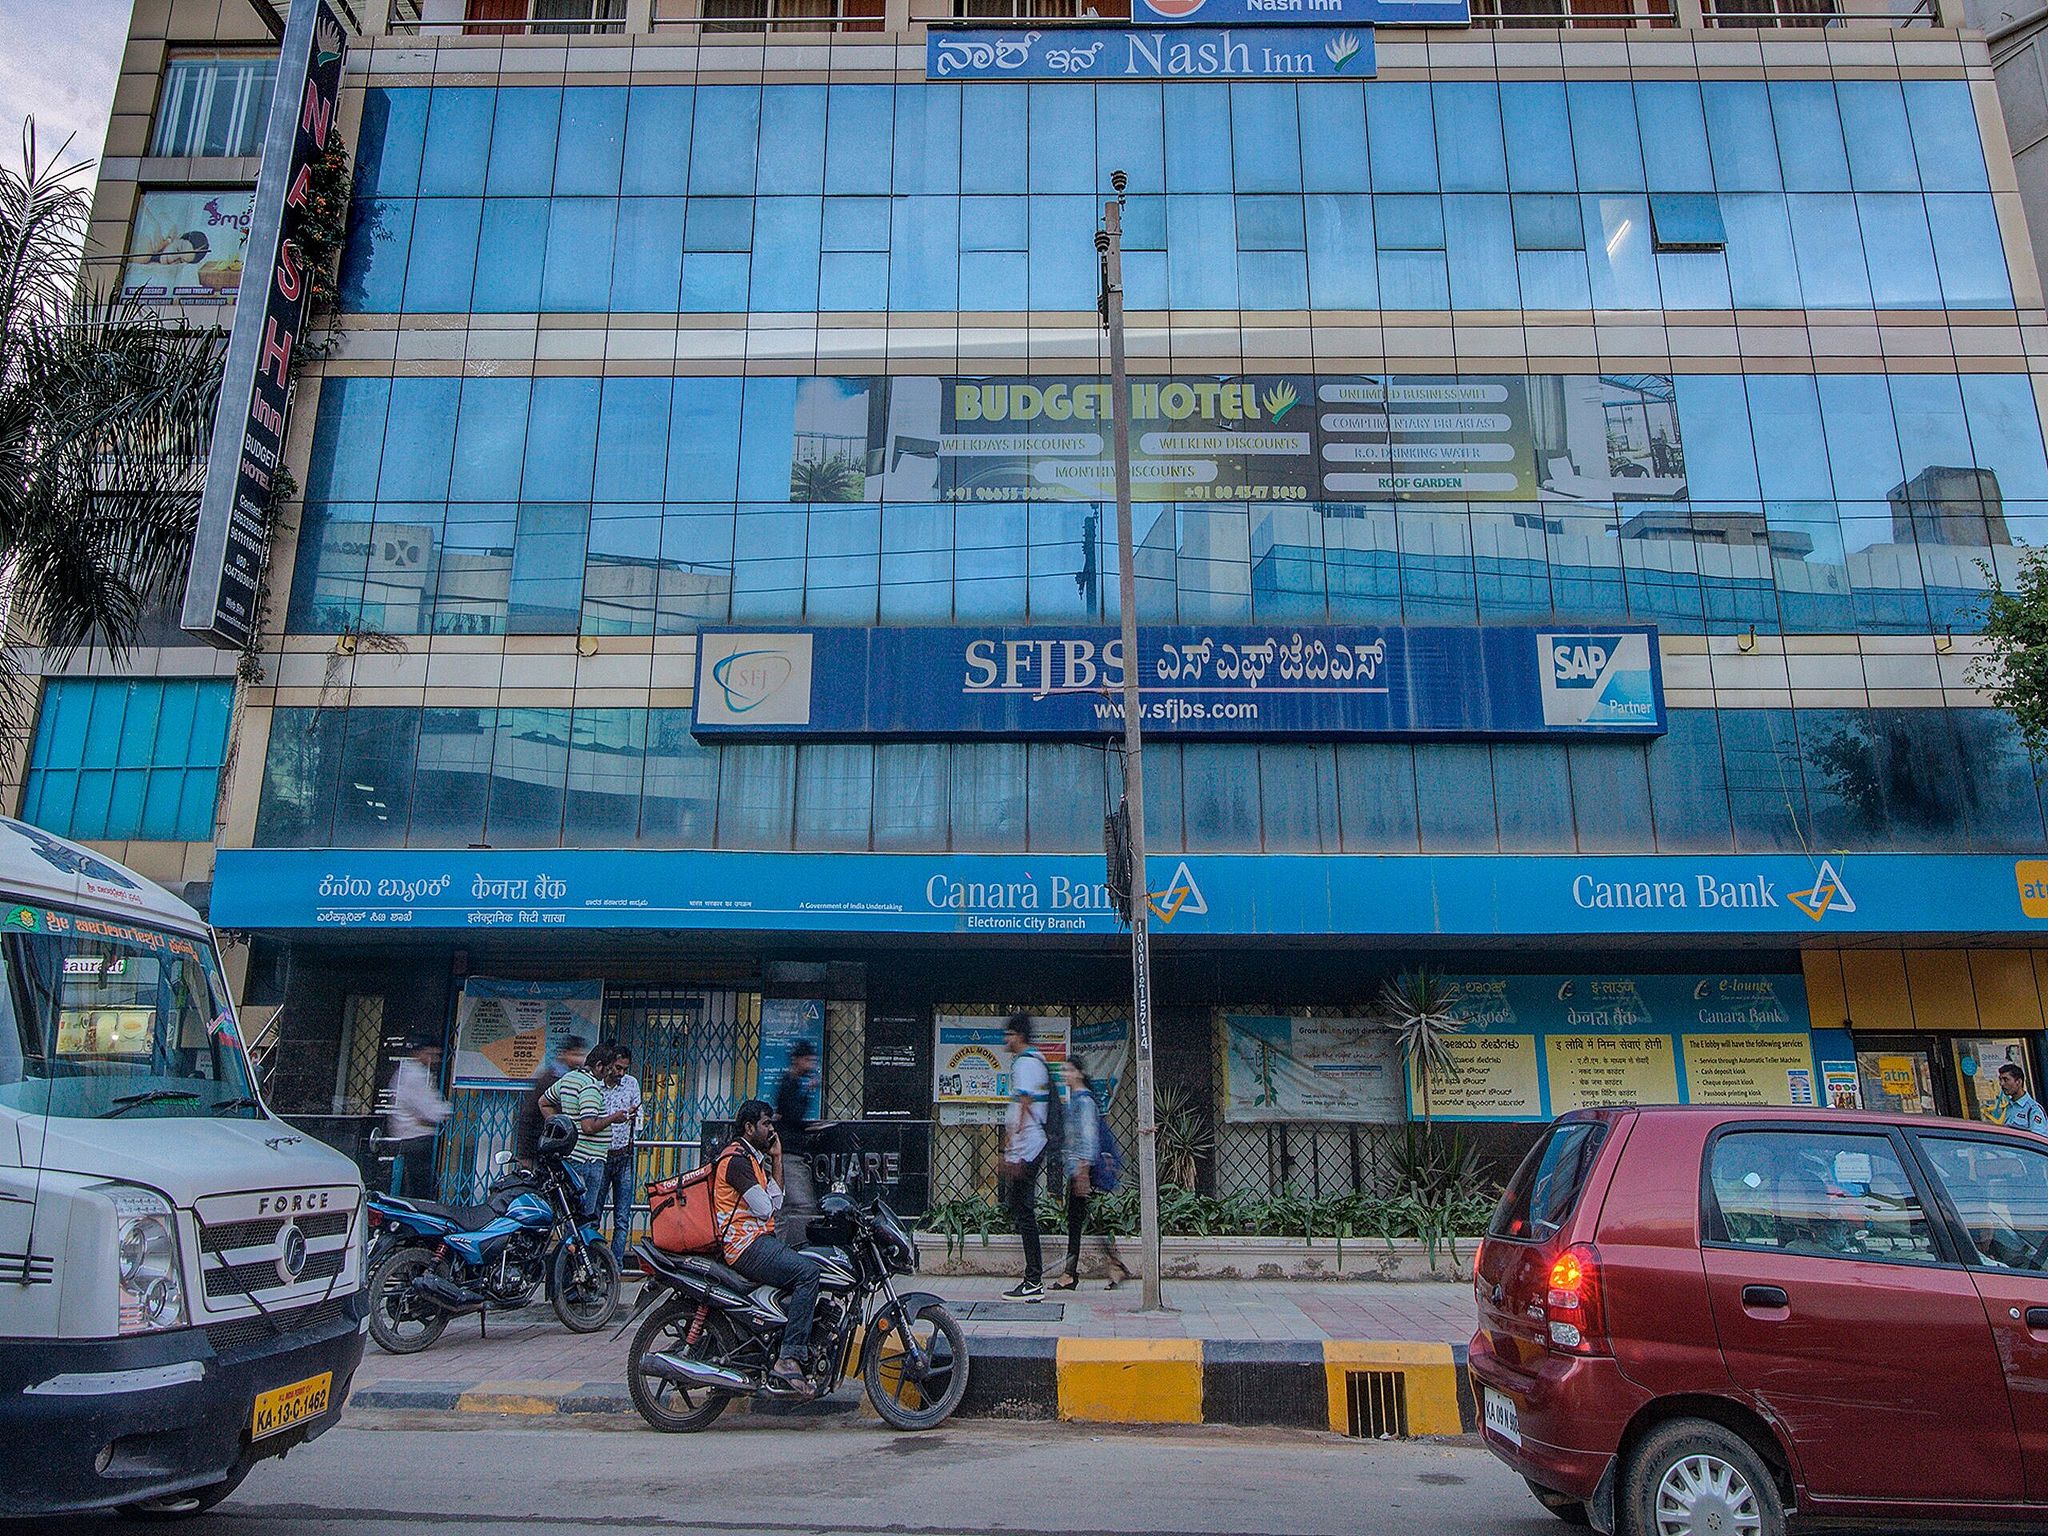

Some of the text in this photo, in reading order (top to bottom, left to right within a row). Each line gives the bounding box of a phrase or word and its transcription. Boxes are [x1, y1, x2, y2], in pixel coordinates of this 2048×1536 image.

[1124, 30, 1316, 75] Nash Inn
[955, 383, 1261, 421] BUDGET HOTEL
[252, 386, 281, 437] Inn
[245, 432, 276, 469] BUDGET
[1013, 437, 1086, 450] DISCOUNTS
[1226, 437, 1298, 449] DISCOUNTS
[241, 458, 271, 491] HOTEL
[1130, 466, 1195, 478] ISCOUNTS
[1378, 477, 1462, 489] ROOF GARDEN
[946, 487, 971, 500] +91
[1185, 486, 1307, 499] +91 80 4347 3030
[964, 639, 1126, 701] SFJBS
[1554, 644, 1604, 680] SAP
[1610, 699, 1652, 715] Partner
[318, 874, 450, 902] ಕೆನರಾ ಬ್ಯಾಂಕ್
[471, 873, 567, 899] केनरा बैंक
[926, 875, 1118, 910] Canara Ban
[1573, 874, 1779, 908] Canara Bank
[2024, 879, 2048, 899] at
[800, 902, 804, 910] A
[805, 902, 842, 911] Government
[866, 904, 903, 912] Undertaking
[518, 910, 539, 924] सिटी
[542, 912, 566, 924] शाखा
[968, 916, 1086, 932] Electronic City Branch
[1719, 979, 1773, 993] e-lounge
[1568, 1008, 1609, 1026] केनरा
[1698, 1008, 1782, 1023] Canara Bank
[1555, 1040, 1562, 1050] इ
[1597, 1038, 1616, 1049] निम्न
[1620, 1038, 1641, 1050] सेवाएं
[1644, 1038, 1662, 1050] होगी
[1690, 1040, 1699, 1048] The
[1705, 1040, 1720, 1049] lobby
[1721, 1040, 1731, 1048] will
[1755, 1039, 1781, 1049] following
[1782, 1039, 1804, 1048] services
[949, 1047, 976, 1068] DIGITAL
[976, 1047, 999, 1069] MONTH
[1884, 1069, 1909, 1081] atm
[1728, 1090, 1748, 1098] printing
[259, 1193, 328, 1215] FORCE
[1486, 1401, 1496, 1421] KA
